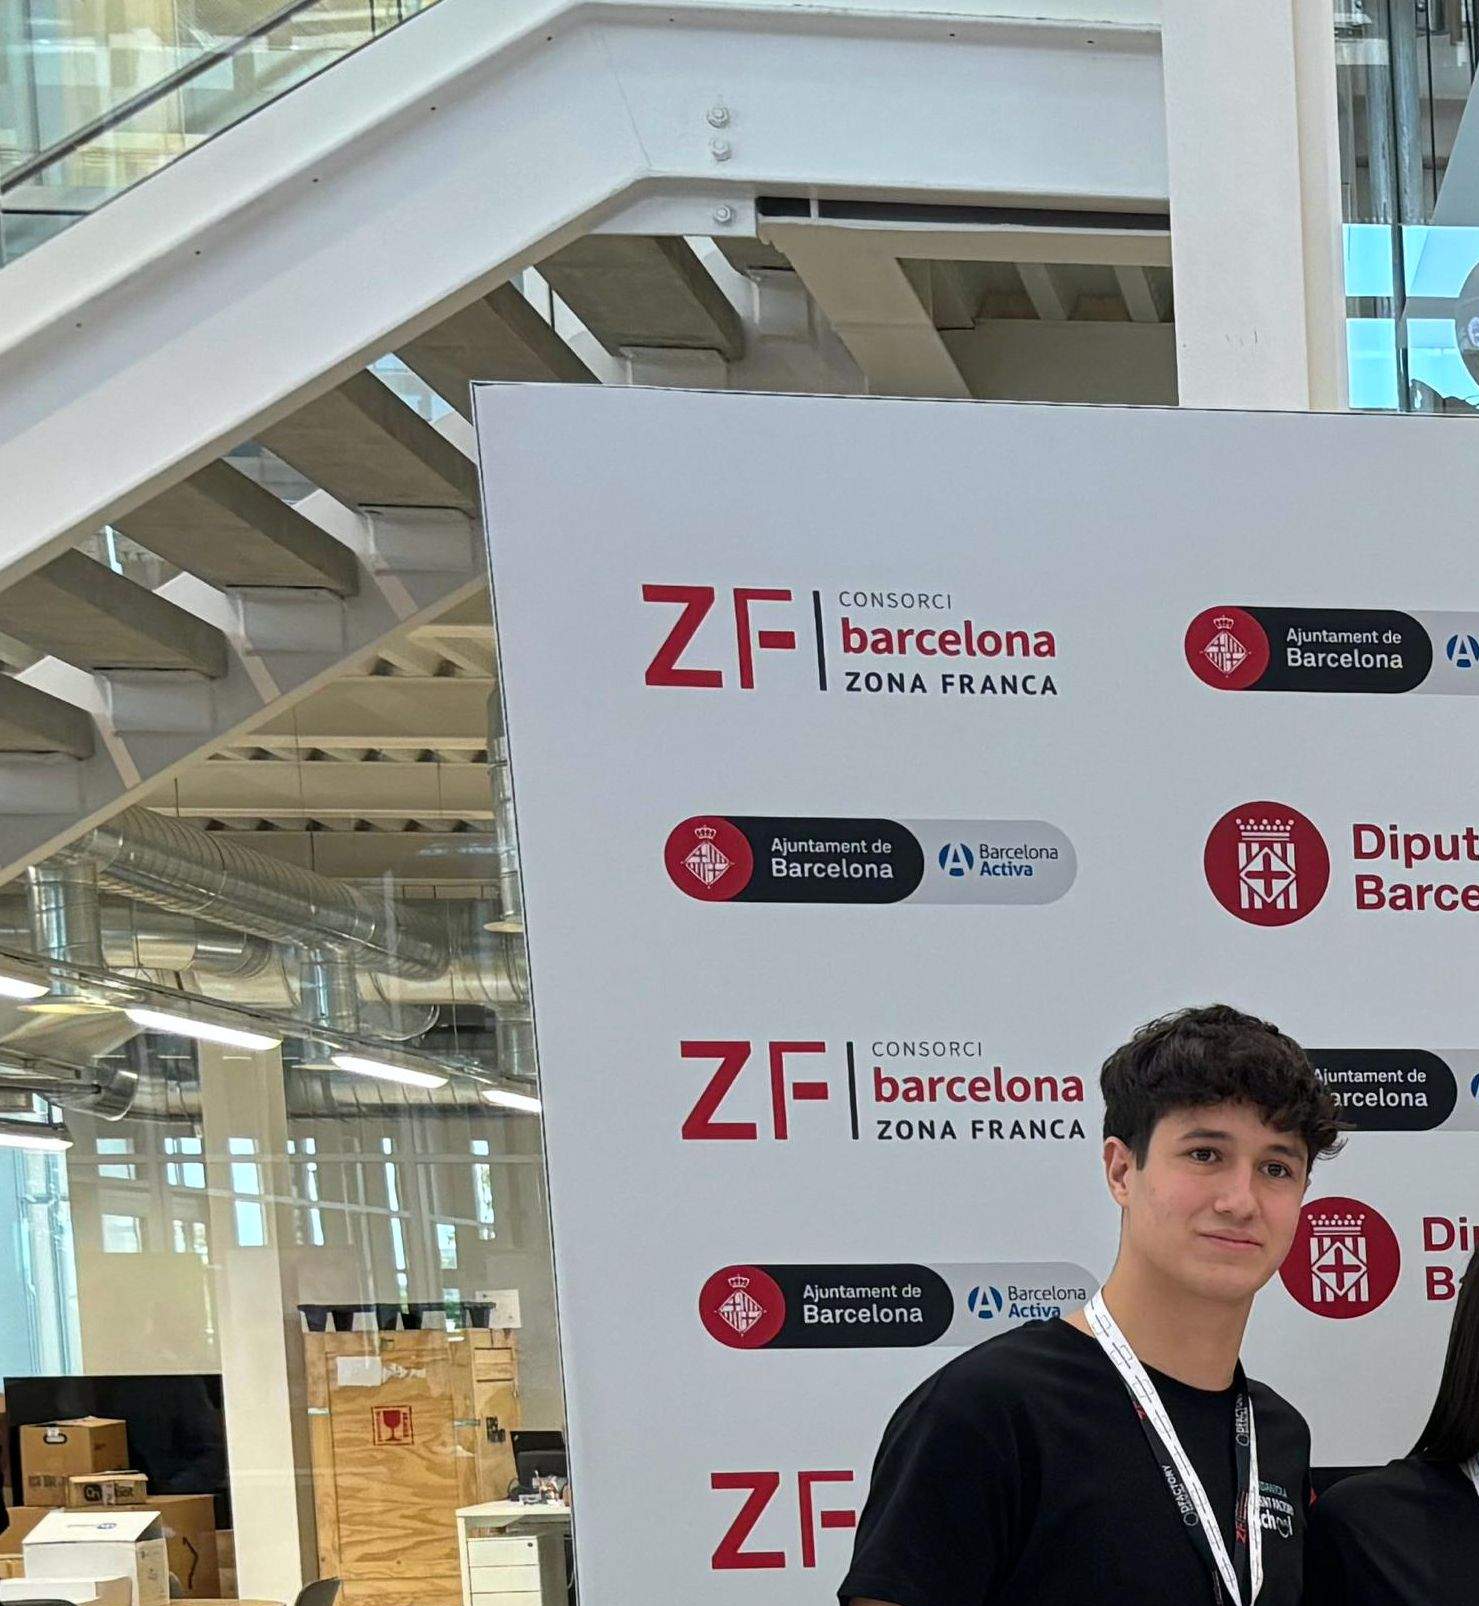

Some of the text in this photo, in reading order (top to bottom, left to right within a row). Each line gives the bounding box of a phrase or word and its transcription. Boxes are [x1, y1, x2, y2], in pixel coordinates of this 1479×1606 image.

[839, 591, 951, 609] CONSORCI
[642, 584, 796, 689] ZF
[841, 617, 1055, 657] barcelona
[1287, 628, 1401, 646] Ajuntament de
[1287, 648, 1403, 668] Barcelona
[845, 672, 1057, 695] ZONA FRANCA
[772, 838, 891, 856] Ajuntament de
[980, 844, 1058, 859] Barcelona
[772, 858, 893, 878] Barcelona
[980, 861, 1033, 876] Activa
[872, 1041, 981, 1057] CONSORCI
[874, 1067, 1083, 1102] barcelona
[1314, 1068, 1426, 1085] Ajuntament de
[681, 1040, 828, 1140] ZF
[1331, 1088, 1428, 1107] arcelona
[877, 1119, 1085, 1140] ZONA FRANCA
[804, 1284, 921, 1302] Ajuntament de
[1008, 1284, 1086, 1301] Barcelona
[804, 1304, 923, 1323] Barcelona
[1008, 1301, 1061, 1318] Activa
